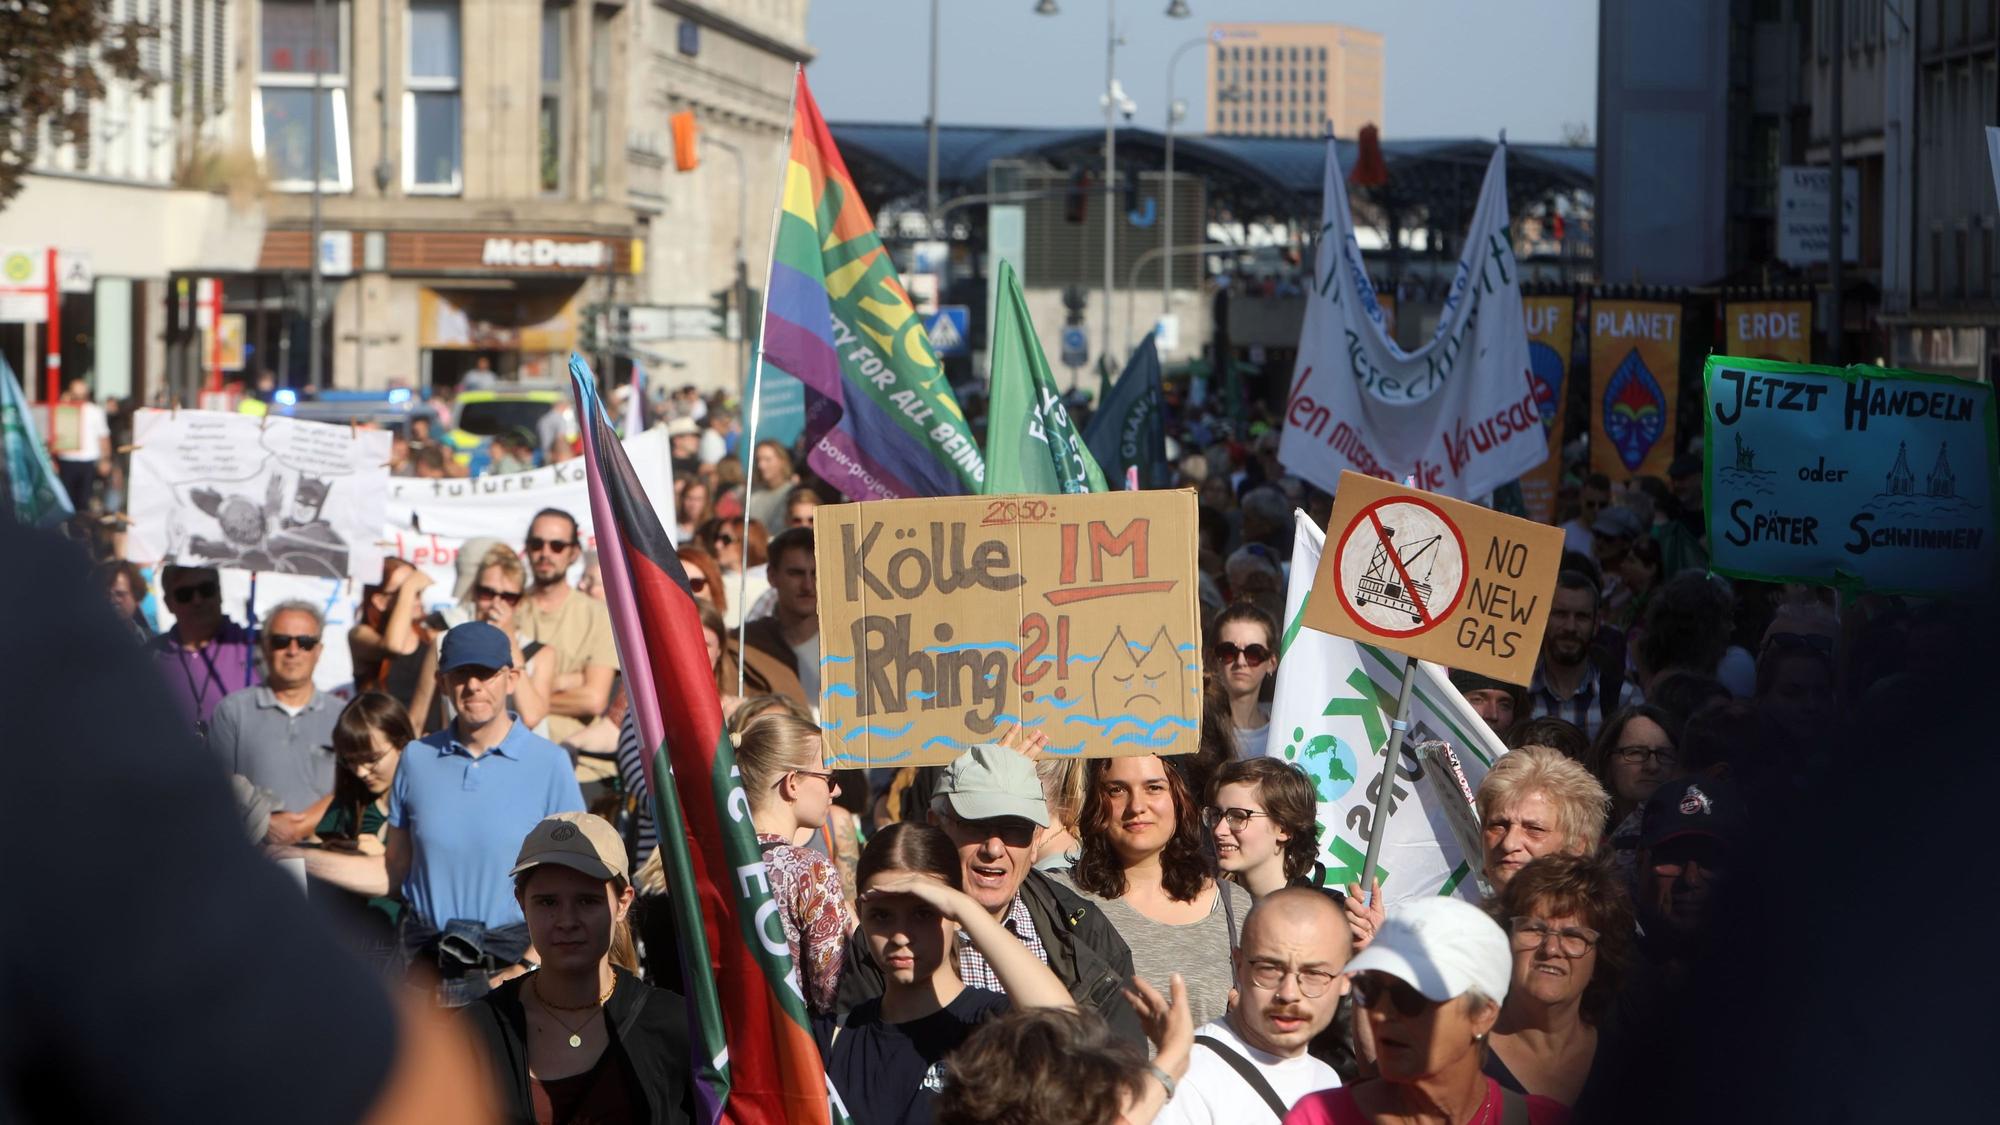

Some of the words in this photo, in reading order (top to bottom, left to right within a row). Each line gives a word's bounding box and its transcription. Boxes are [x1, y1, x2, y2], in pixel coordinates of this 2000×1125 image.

[1596, 312, 1677, 341] PLANET
[1738, 312, 1802, 340] ERDE
[848, 346, 896, 390] FOR
[889, 390, 933, 426] ALL
[1715, 370, 1828, 425] JETZT
[1844, 379, 1974, 431] HANDELN
[1798, 456, 1849, 482] oder
[981, 500, 1057, 525] 2050:
[1724, 499, 1819, 546] SPÄTER
[1844, 512, 1984, 554] SCHWIMMEN
[840, 521, 1027, 602] Kölle
[1059, 518, 1151, 585] IM
[1485, 536, 1528, 579] NO
[1467, 577, 1538, 625] NEW
[1457, 617, 1522, 658] GAS
